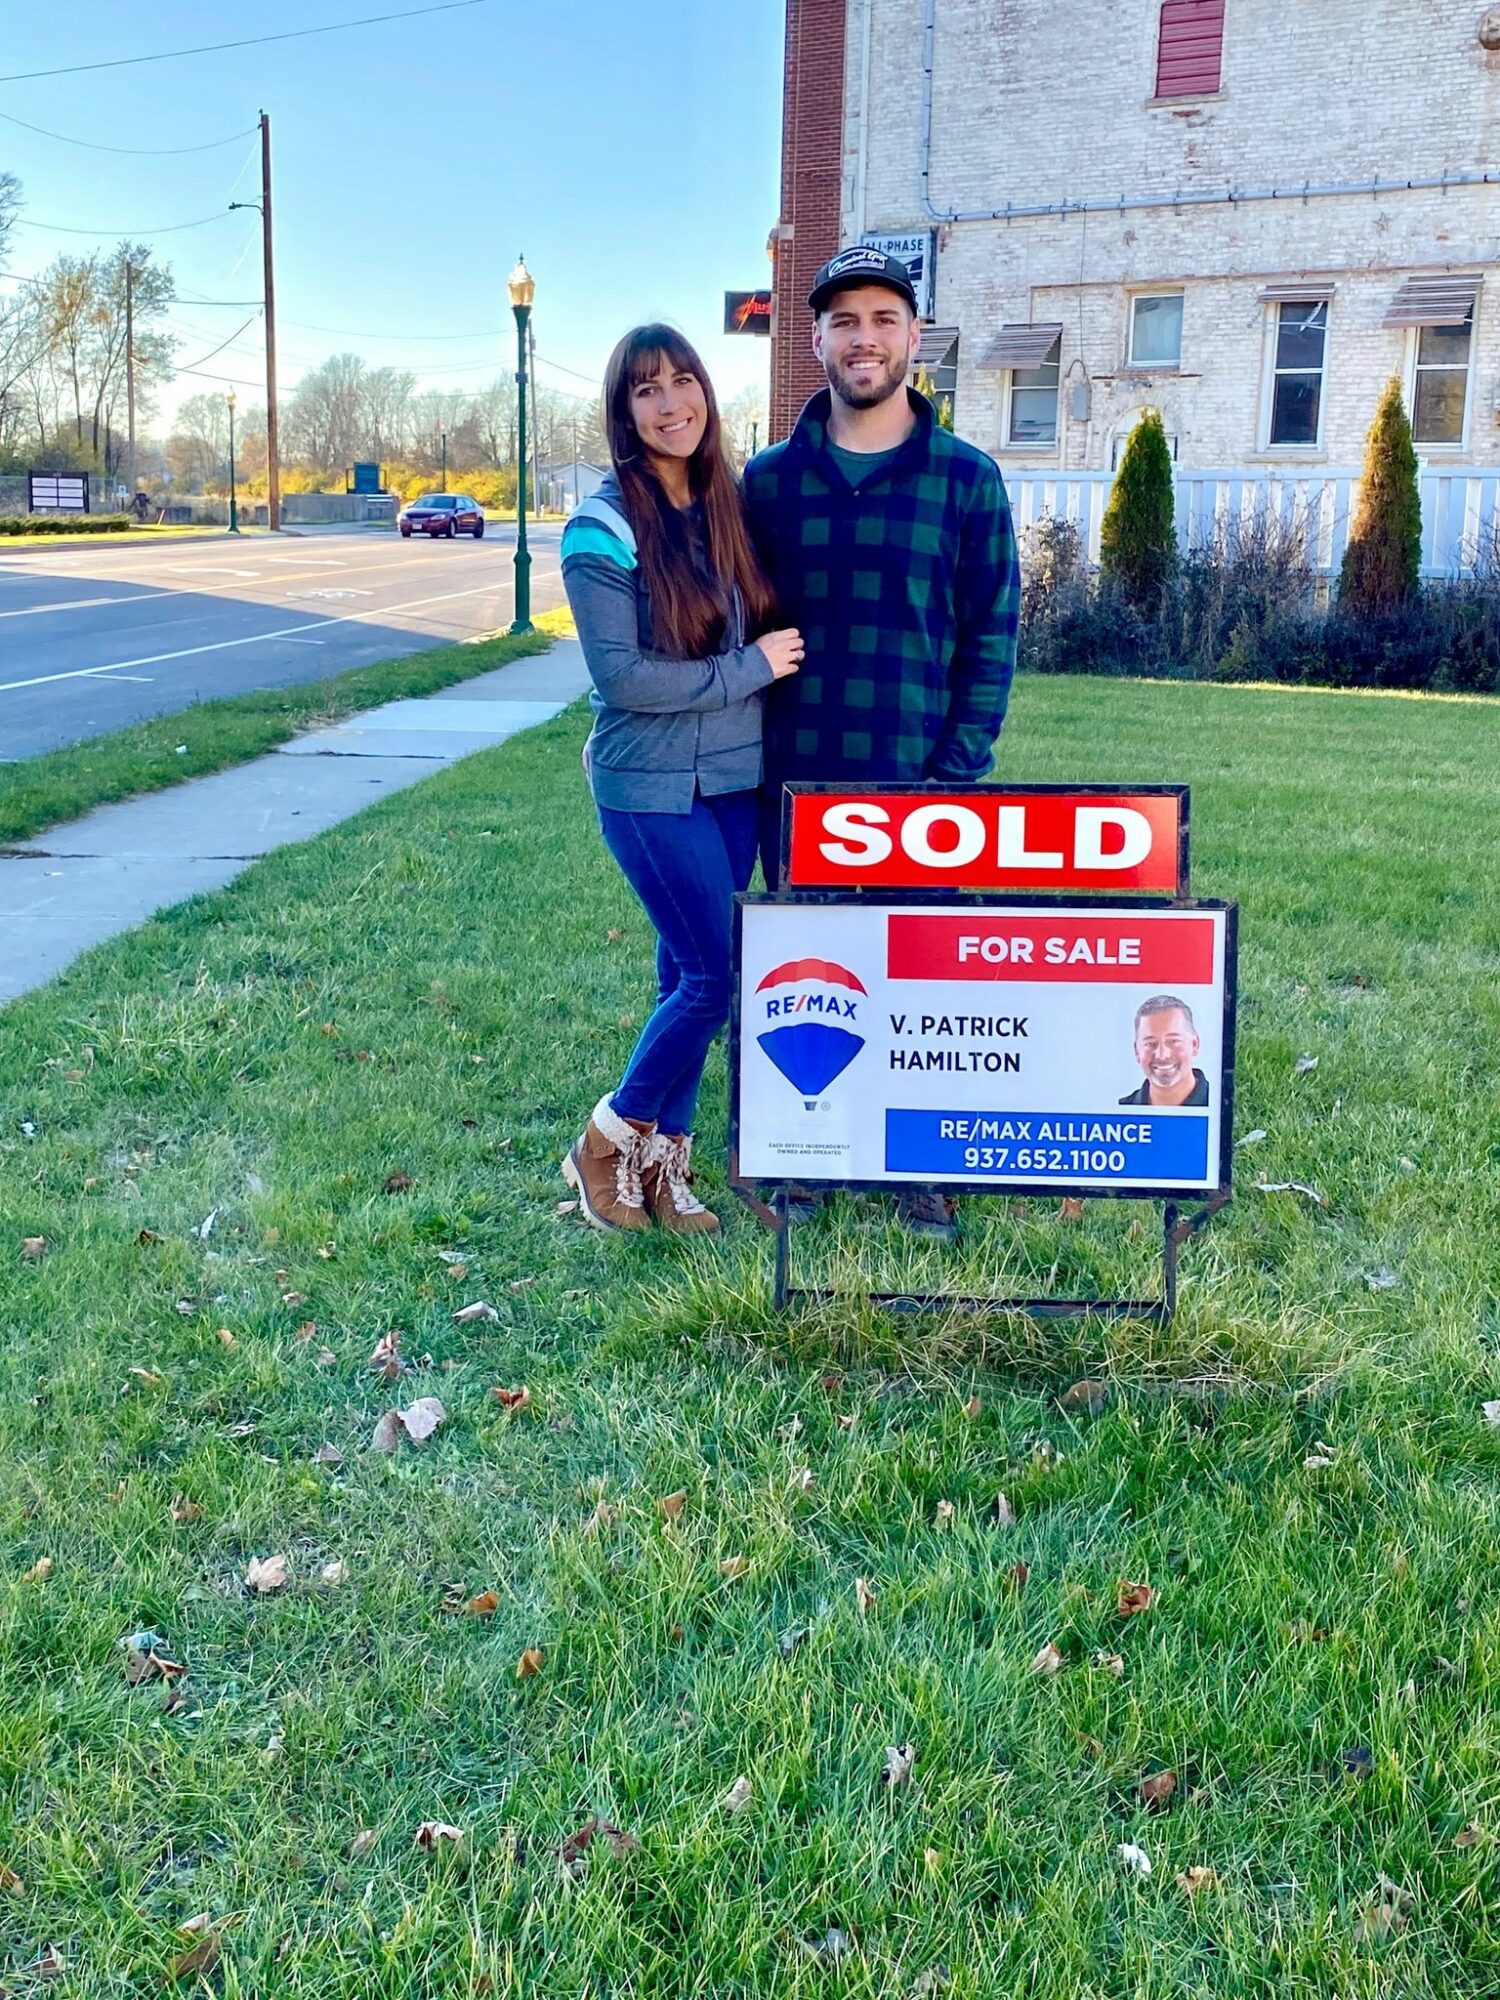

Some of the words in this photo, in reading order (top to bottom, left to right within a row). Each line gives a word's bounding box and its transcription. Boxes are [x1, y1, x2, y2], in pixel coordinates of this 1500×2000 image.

[818, 802, 1153, 870] SOLD
[958, 936, 1034, 963] FOR
[1044, 937, 1141, 965] SALE
[766, 994, 858, 1021] RE/MAX
[890, 1014, 913, 1036] V.
[921, 1015, 1029, 1038] PATRICK
[890, 1049, 1021, 1073] HAMILTON
[940, 1118, 1032, 1142] RE/MAX
[1037, 1121, 1152, 1143] ALLIANCE
[964, 1146, 1126, 1172] 937.652.1100
